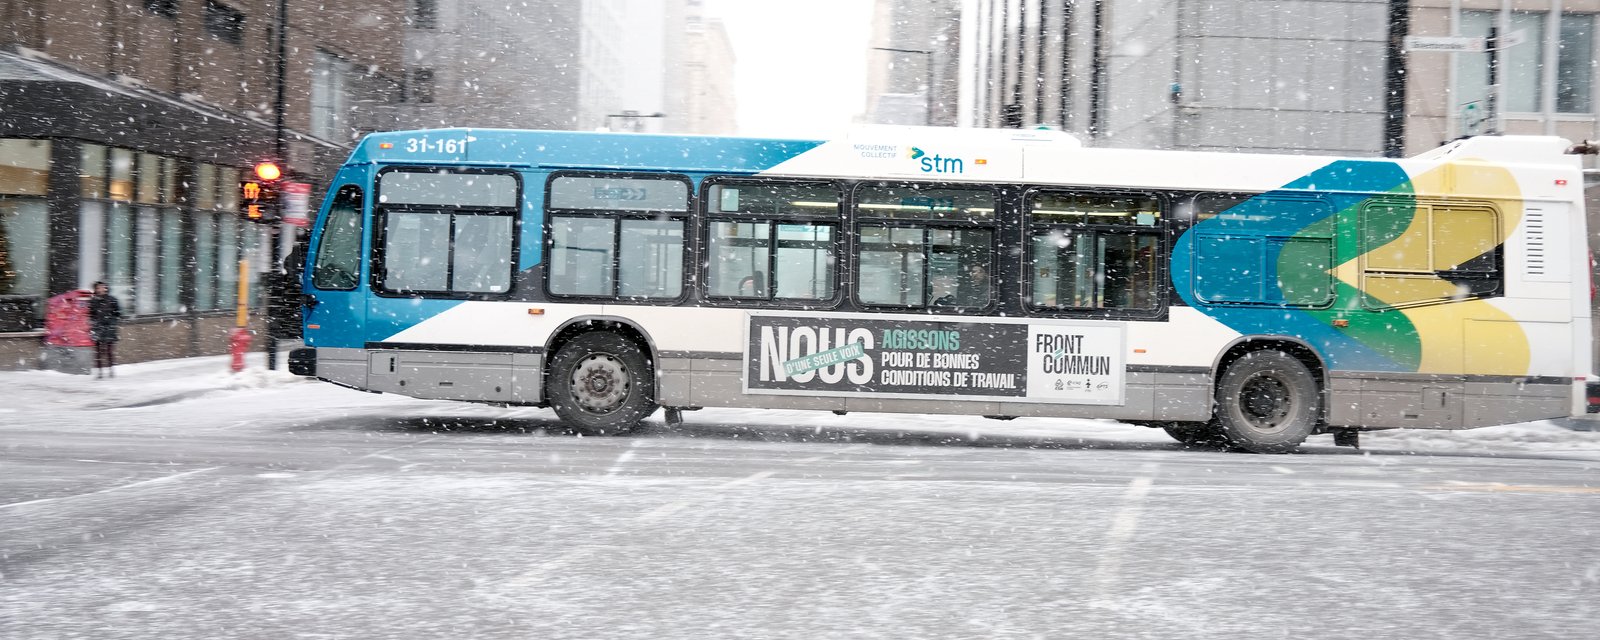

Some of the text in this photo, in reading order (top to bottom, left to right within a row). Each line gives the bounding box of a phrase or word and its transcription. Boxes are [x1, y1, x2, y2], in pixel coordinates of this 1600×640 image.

[406, 138, 466, 154] 31-161
[853, 144, 897, 152] MOUVEMENT
[861, 151, 897, 159] COLLECTIF
[920, 153, 963, 173] stm
[881, 329, 960, 351] AGISSONS
[1036, 333, 1085, 354] FRONT
[760, 325, 875, 385] NOUS
[785, 344, 861, 374] D'UNE SEULE VOIX
[881, 351, 980, 370] POUR DE BONNES
[1043, 354, 1110, 375] COMMUN
[881, 370, 1017, 389] CONDITIONS DE TRAVAIL
